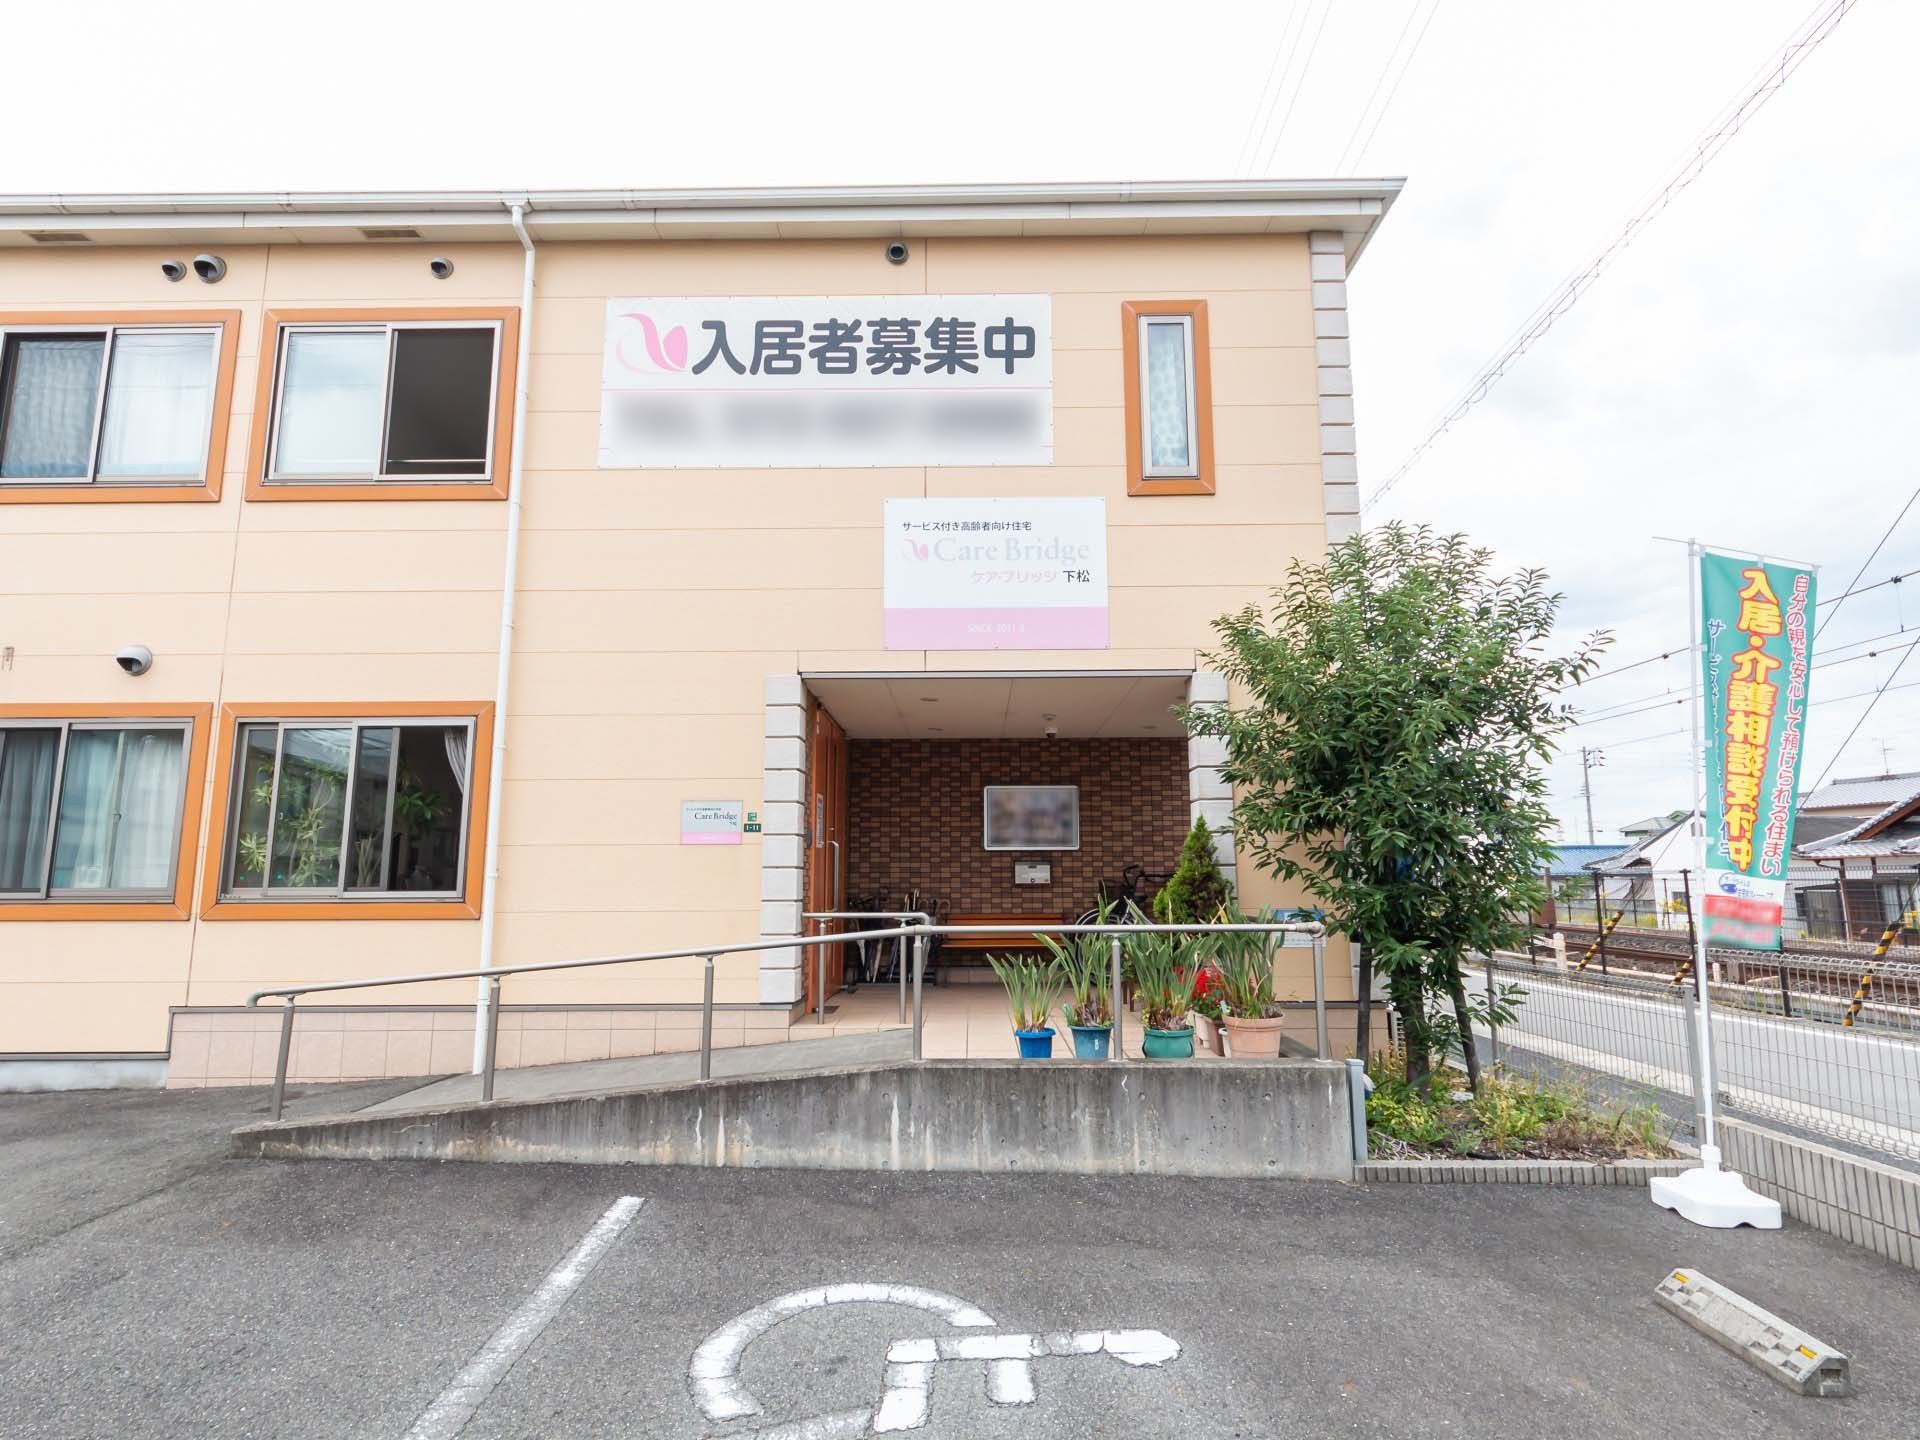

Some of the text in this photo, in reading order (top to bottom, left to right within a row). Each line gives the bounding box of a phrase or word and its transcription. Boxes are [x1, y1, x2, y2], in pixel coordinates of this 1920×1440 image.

[692, 316, 1036, 376] 入居者募集中
[903, 521, 1032, 532] サービス付き高齢者向け住宅
[934, 537, 1090, 566] Care Bridge
[1062, 569, 1090, 583] 下松
[1725, 569, 1783, 872] 入居・介護相談受付中
[1760, 576, 1810, 875] 自分の親を安心して預けられる住まい
[694, 812, 713, 820] Care
[714, 812, 738, 821] Bridge
